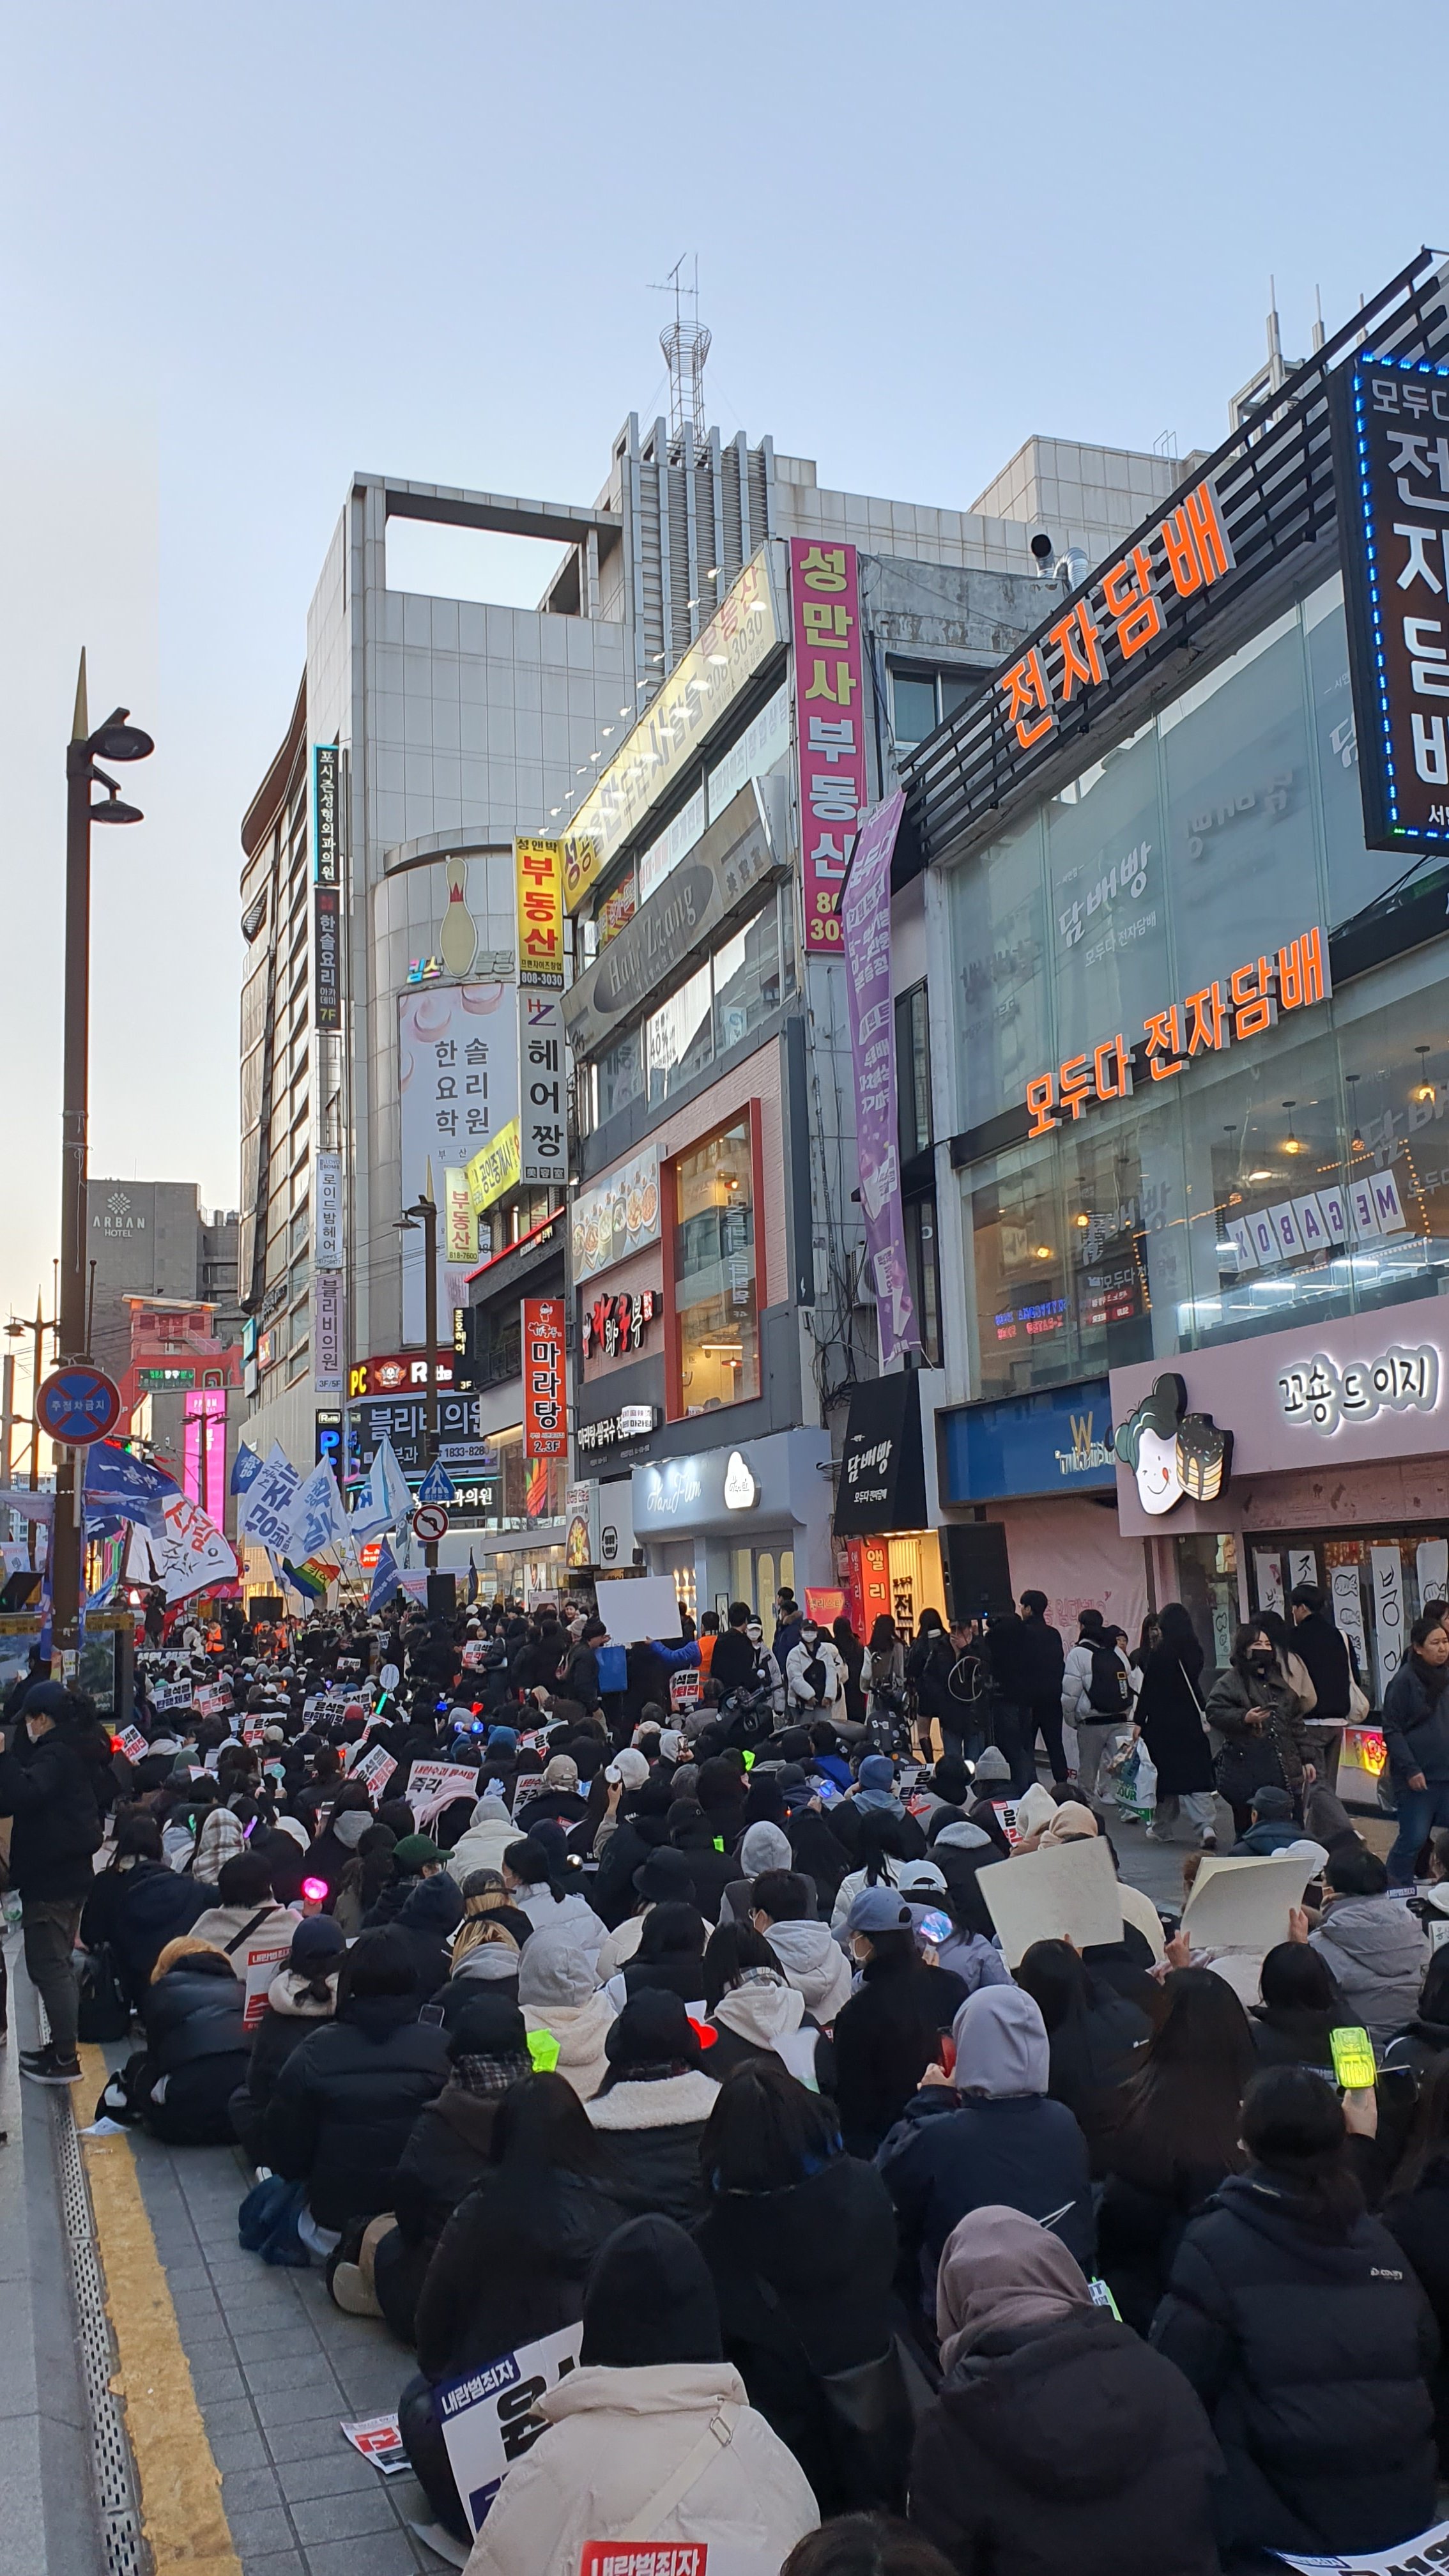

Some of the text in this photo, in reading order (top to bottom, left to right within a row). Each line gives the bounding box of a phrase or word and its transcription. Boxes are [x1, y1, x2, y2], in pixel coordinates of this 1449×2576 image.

[1000, 480, 1230, 750] 전자담배
[800, 546, 857, 881] 성만사 부동산
[521, 855, 559, 958] 부동산
[319, 914, 336, 986] 한솔요리
[1085, 910, 1156, 968] 모두다 전자담배
[521, 972, 563, 986] 808-3030
[320, 1008, 336, 1022] 7F
[1026, 1034, 1128, 1138] 모두다
[1144, 926, 1324, 1082] 전자담배
[434, 1038, 489, 1068] 한솔
[436, 1072, 488, 1100] 요리
[527, 1039, 564, 1157] 헤어짱
[436, 1107, 489, 1137] 학원
[479, 1140, 514, 1194] 공인중개사
[93, 1216, 146, 1229] ARBAN
[104, 1229, 133, 1238] HOTEL
[452, 1190, 471, 1250] 부동산
[449, 1250, 477, 1260] 818-7600
[321, 1279, 339, 1372] 블리비의원
[351, 1366, 367, 1397] PC
[460, 1381, 472, 1390] 3F
[532, 1341, 561, 1430] 마라탕
[51, 1399, 105, 1412] 주정차금지
[534, 1441, 560, 1452] 2.3F
[314, 1701, 346, 1715] 윤석열
[410, 1777, 443, 1795] 즉각
[519, 1778, 542, 1788] 내란수
[440, 2359, 516, 2415] 내란범죄자
[591, 2549, 700, 2576] 내란범죄자
